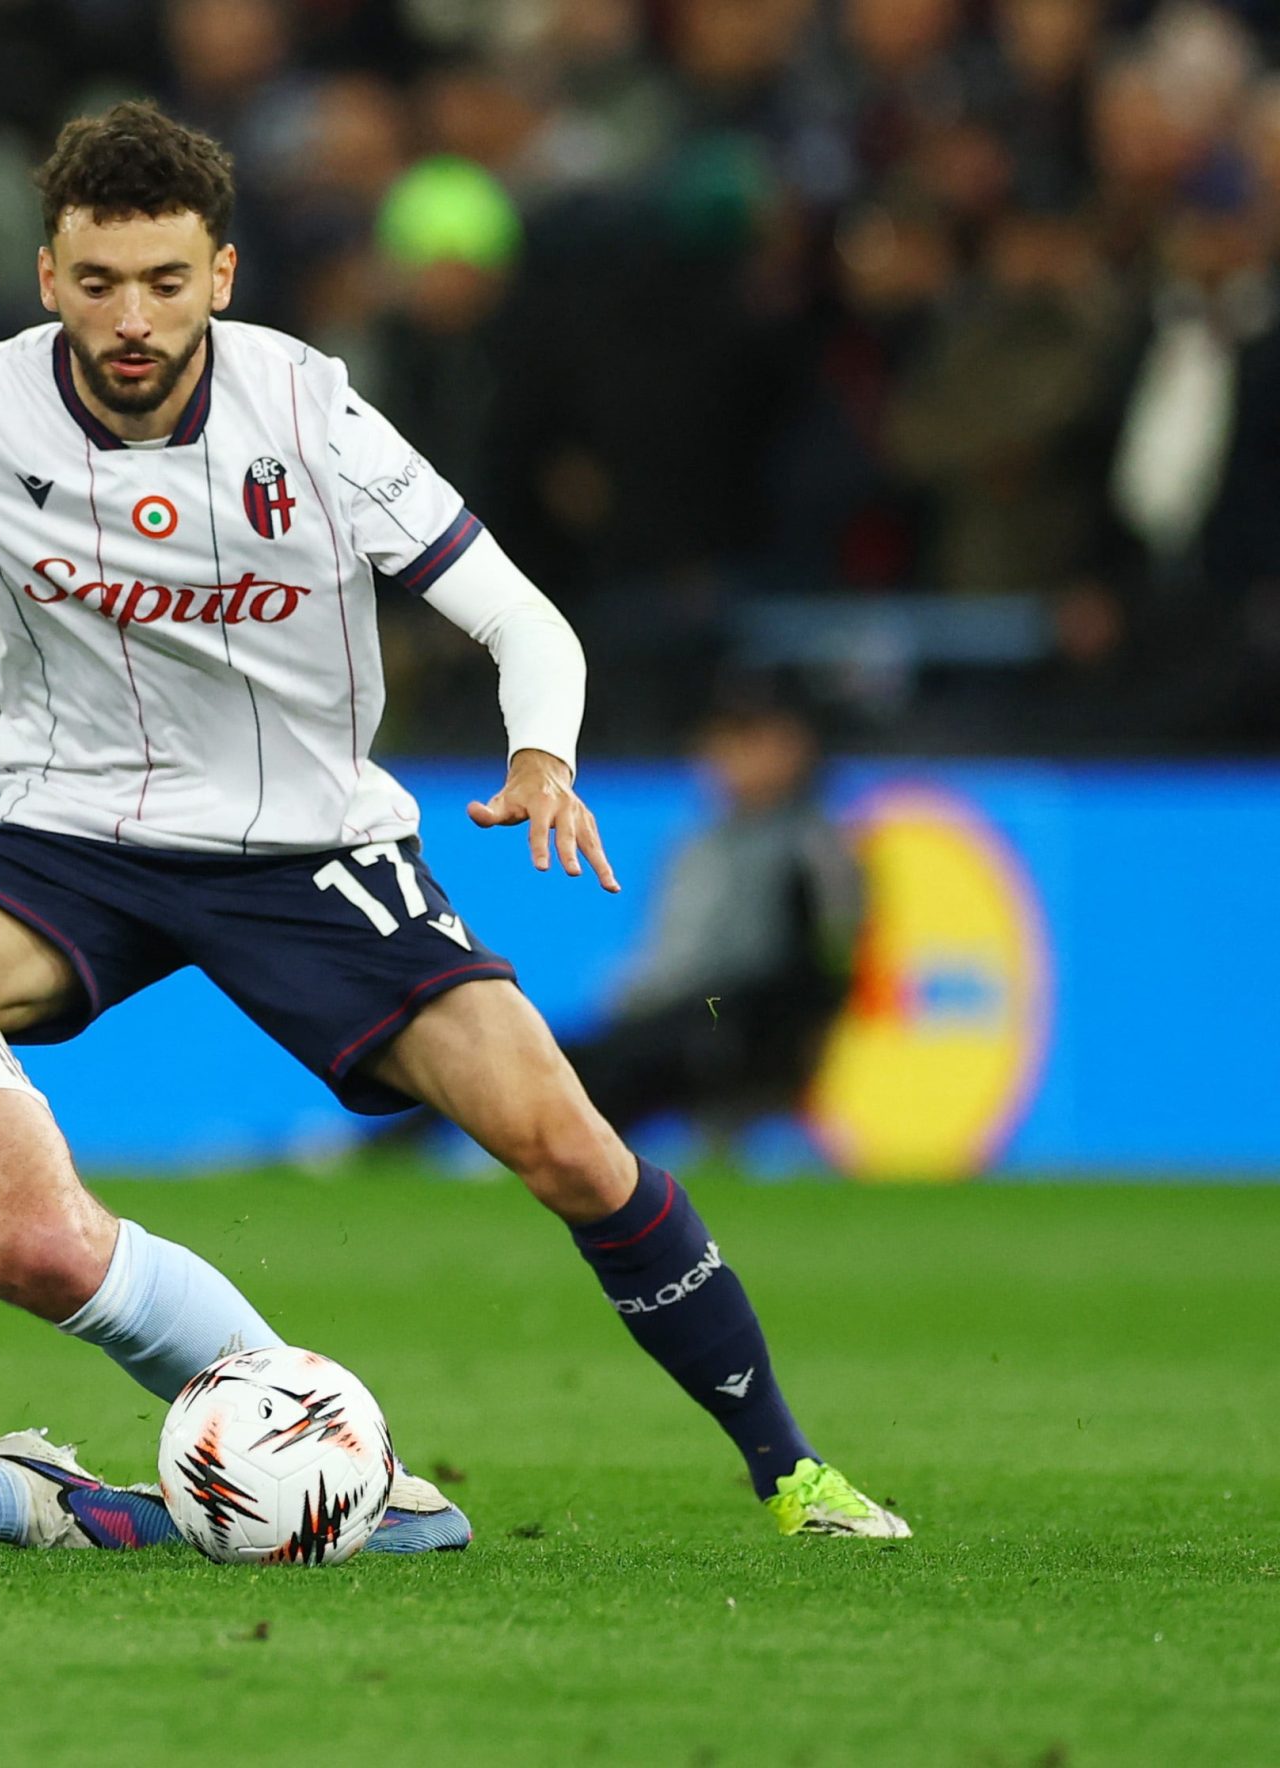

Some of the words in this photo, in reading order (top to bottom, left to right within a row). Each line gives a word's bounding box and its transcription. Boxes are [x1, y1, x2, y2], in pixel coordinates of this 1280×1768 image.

[251, 458, 281, 479] BFC
[24, 557, 311, 628] Saputo
[312, 841, 428, 937] 17
[603, 1240, 721, 1314] OLOGN
